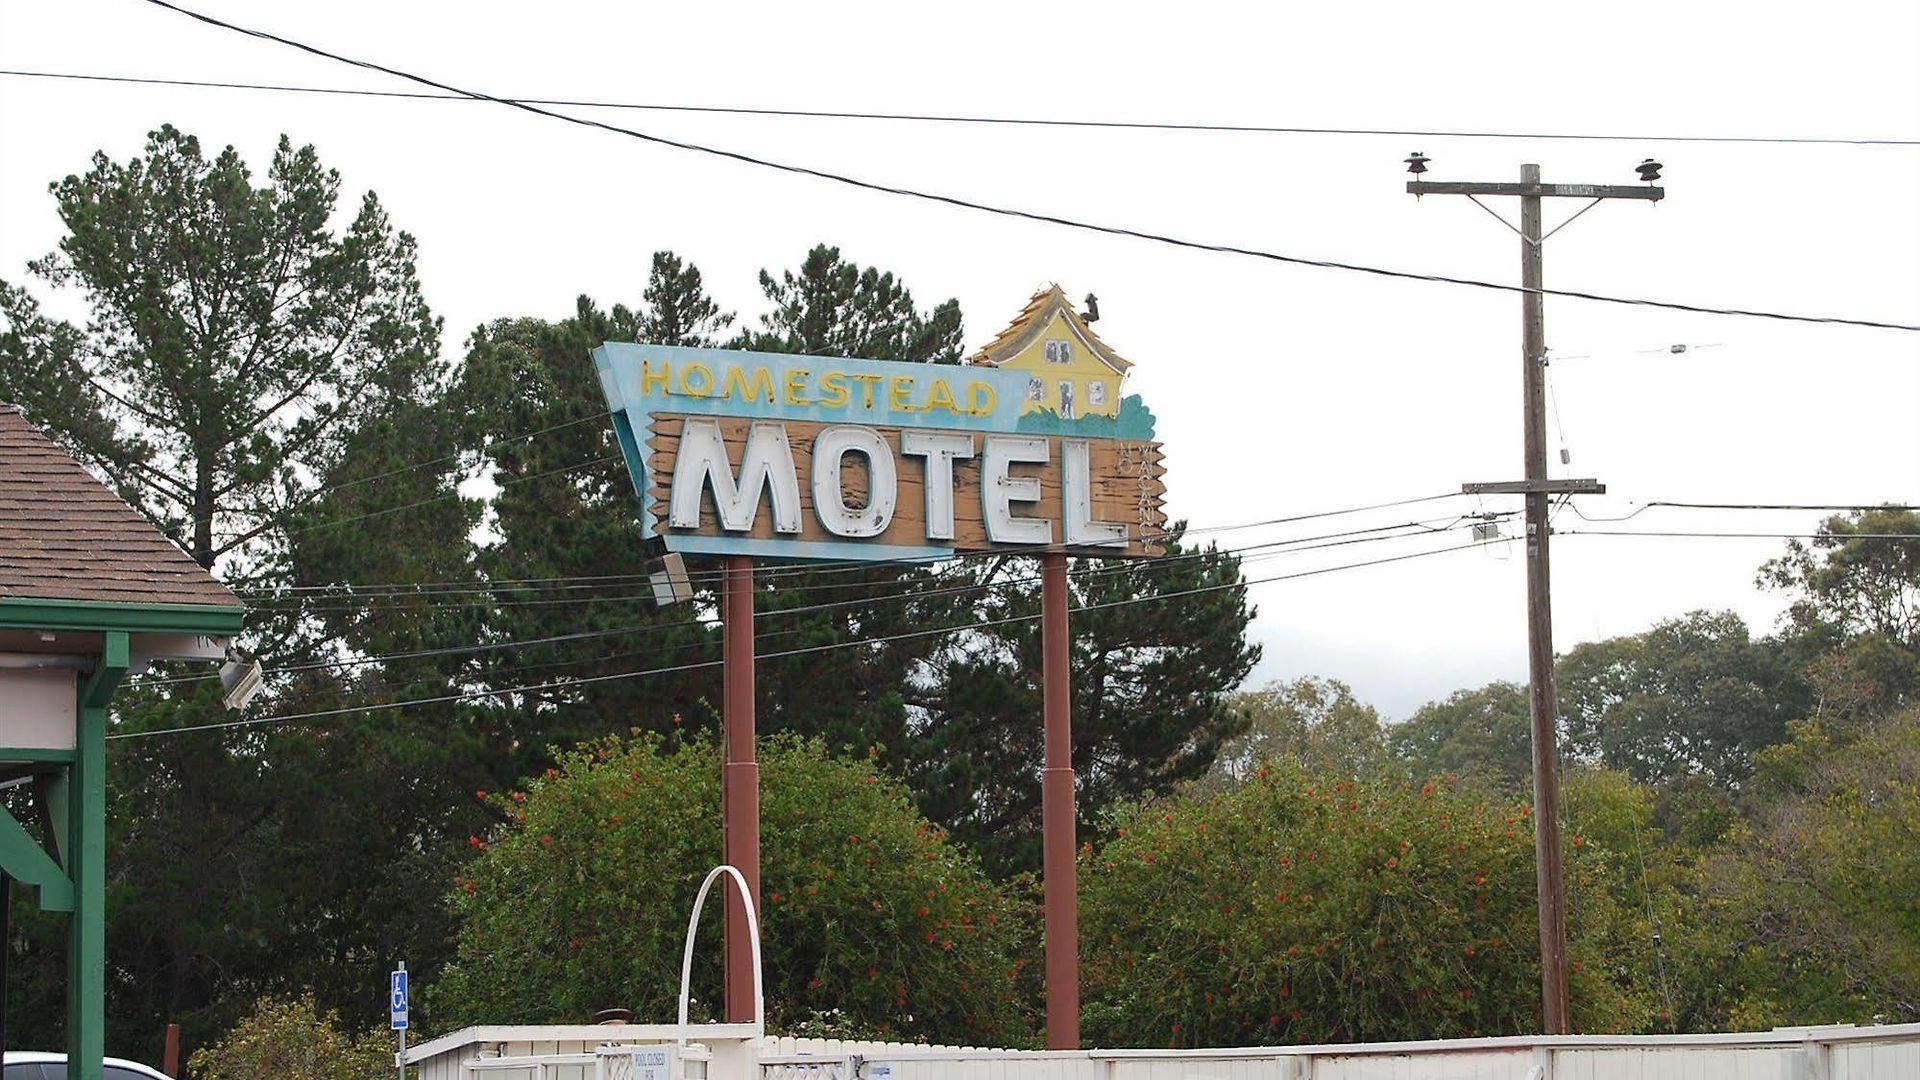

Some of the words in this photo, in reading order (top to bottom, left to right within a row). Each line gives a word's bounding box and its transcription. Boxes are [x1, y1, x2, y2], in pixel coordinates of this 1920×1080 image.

[641, 361, 997, 417] HOMESTEAD
[668, 416, 1129, 549] MOTEL
[1138, 444, 1155, 554] VACANCY
